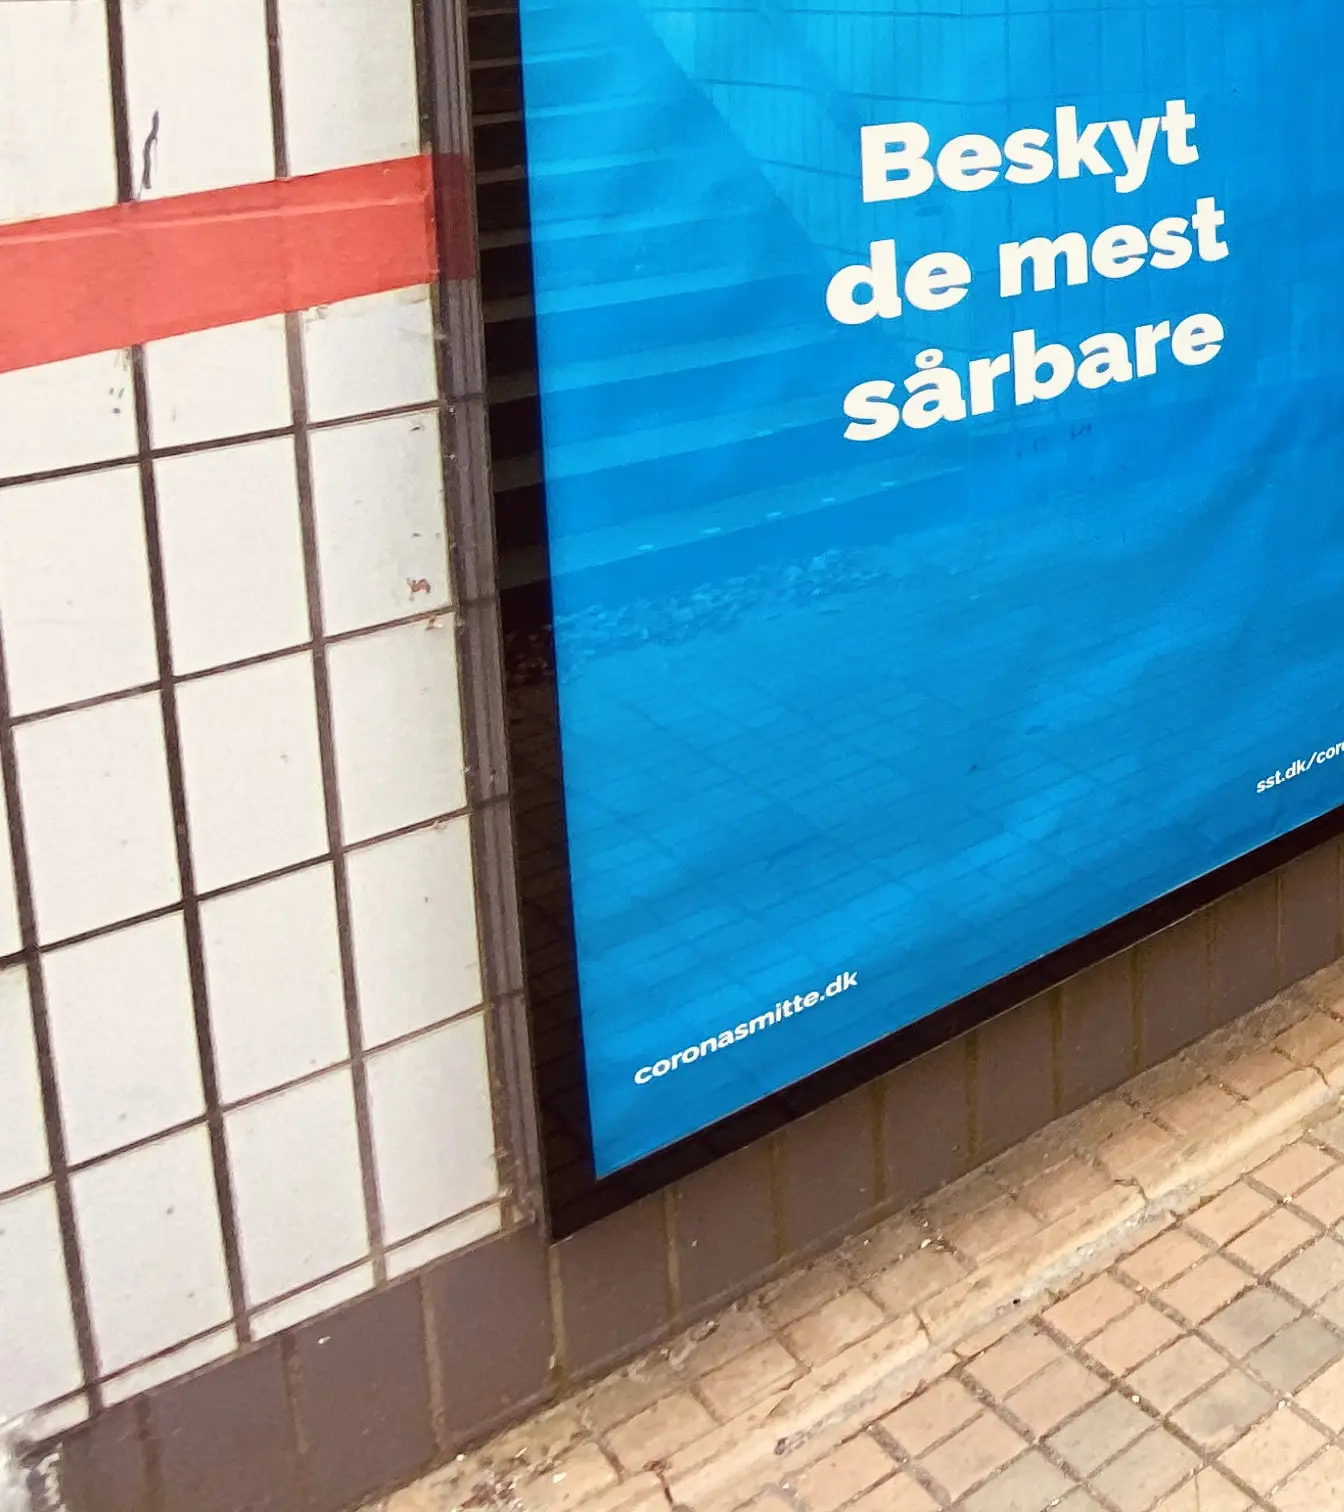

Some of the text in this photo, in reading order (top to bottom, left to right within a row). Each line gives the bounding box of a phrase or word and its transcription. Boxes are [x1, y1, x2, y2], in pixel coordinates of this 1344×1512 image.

[860, 99, 1200, 203] Beskyt
[825, 196, 1230, 325] de mest
[843, 313, 1225, 442] sårbare
[634, 970, 858, 1085] coronasmitte.dk
